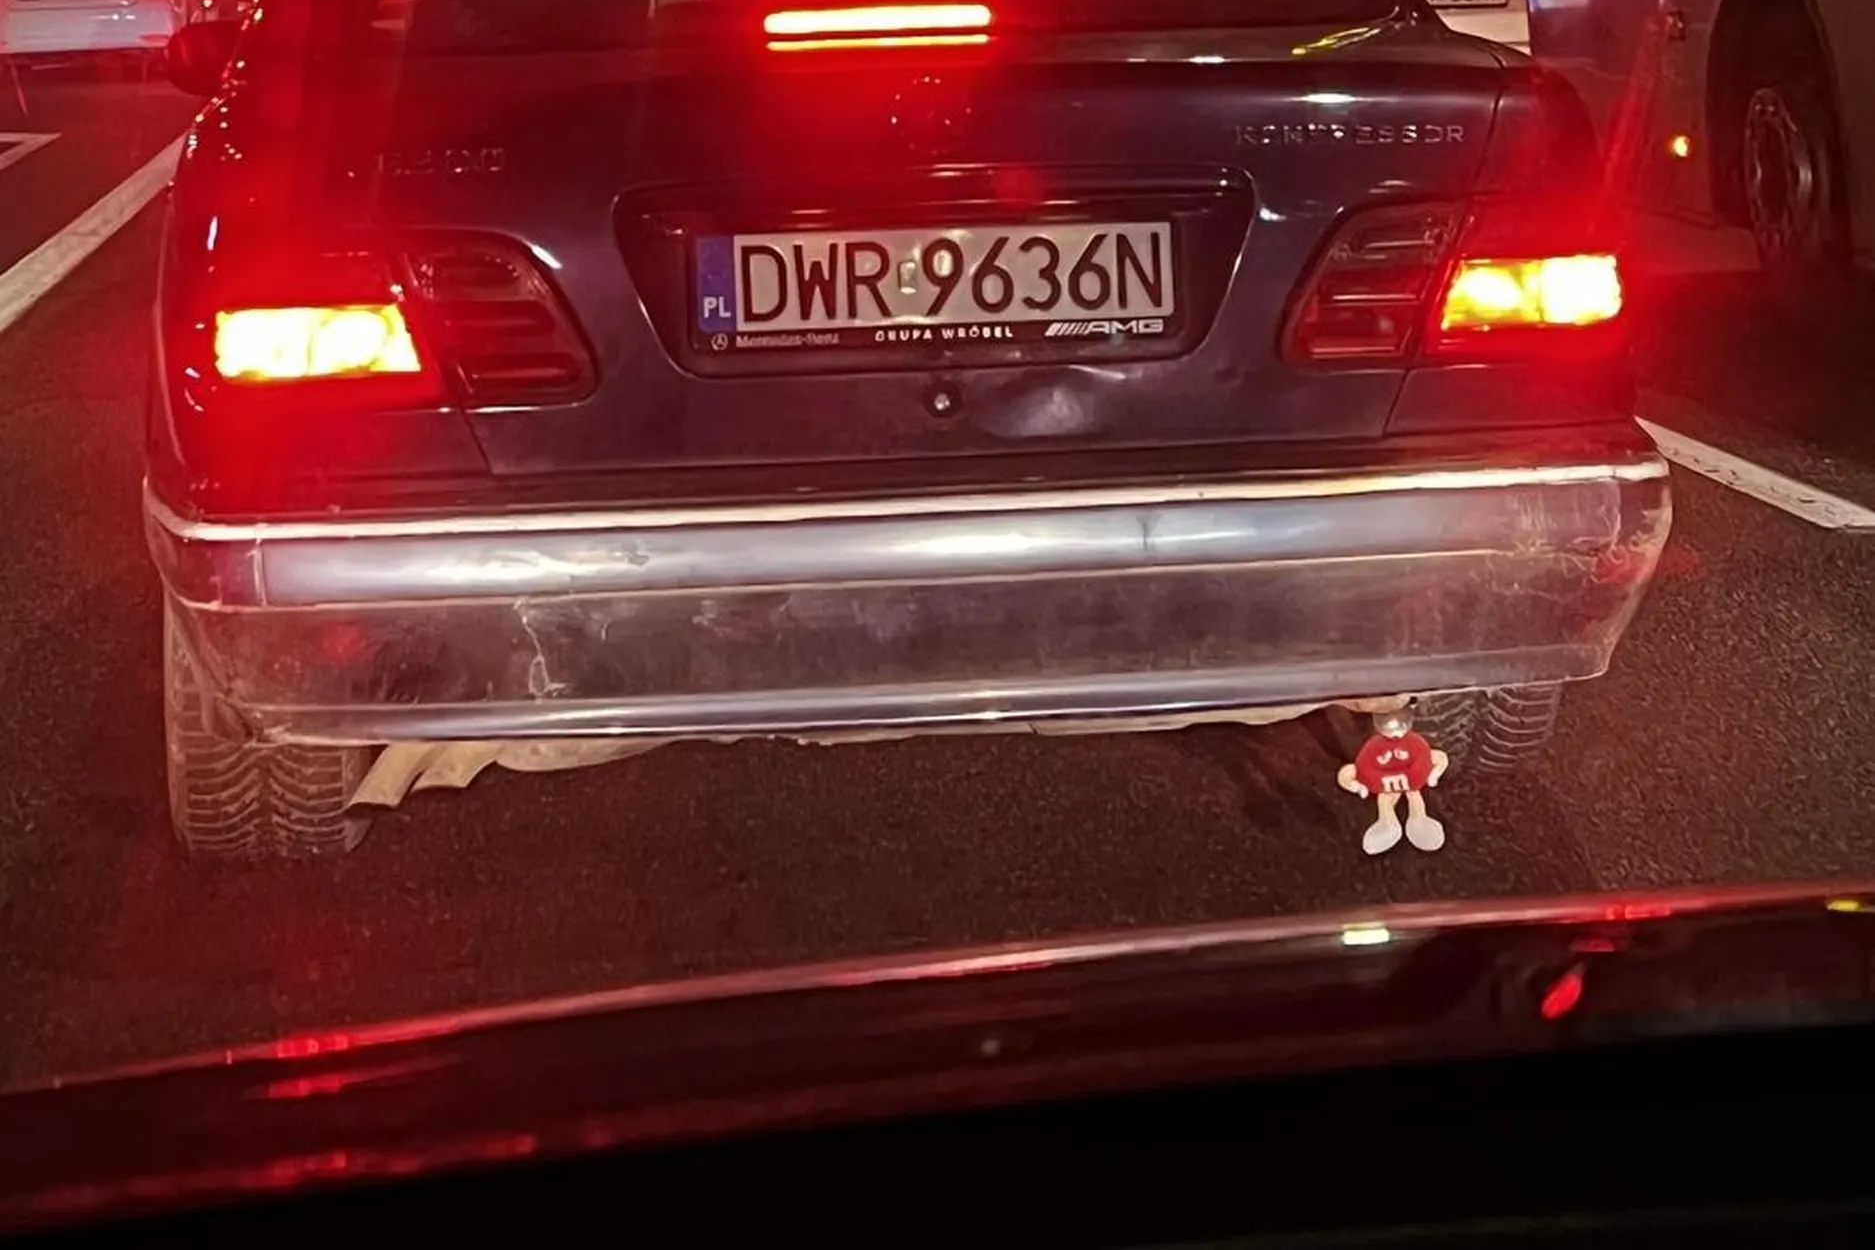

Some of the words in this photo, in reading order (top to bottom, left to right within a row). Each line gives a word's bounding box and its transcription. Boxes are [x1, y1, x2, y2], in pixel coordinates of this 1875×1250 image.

[739, 241, 892, 323] DWR
[920, 231, 1165, 319] 9636N
[703, 297, 732, 319] PL
